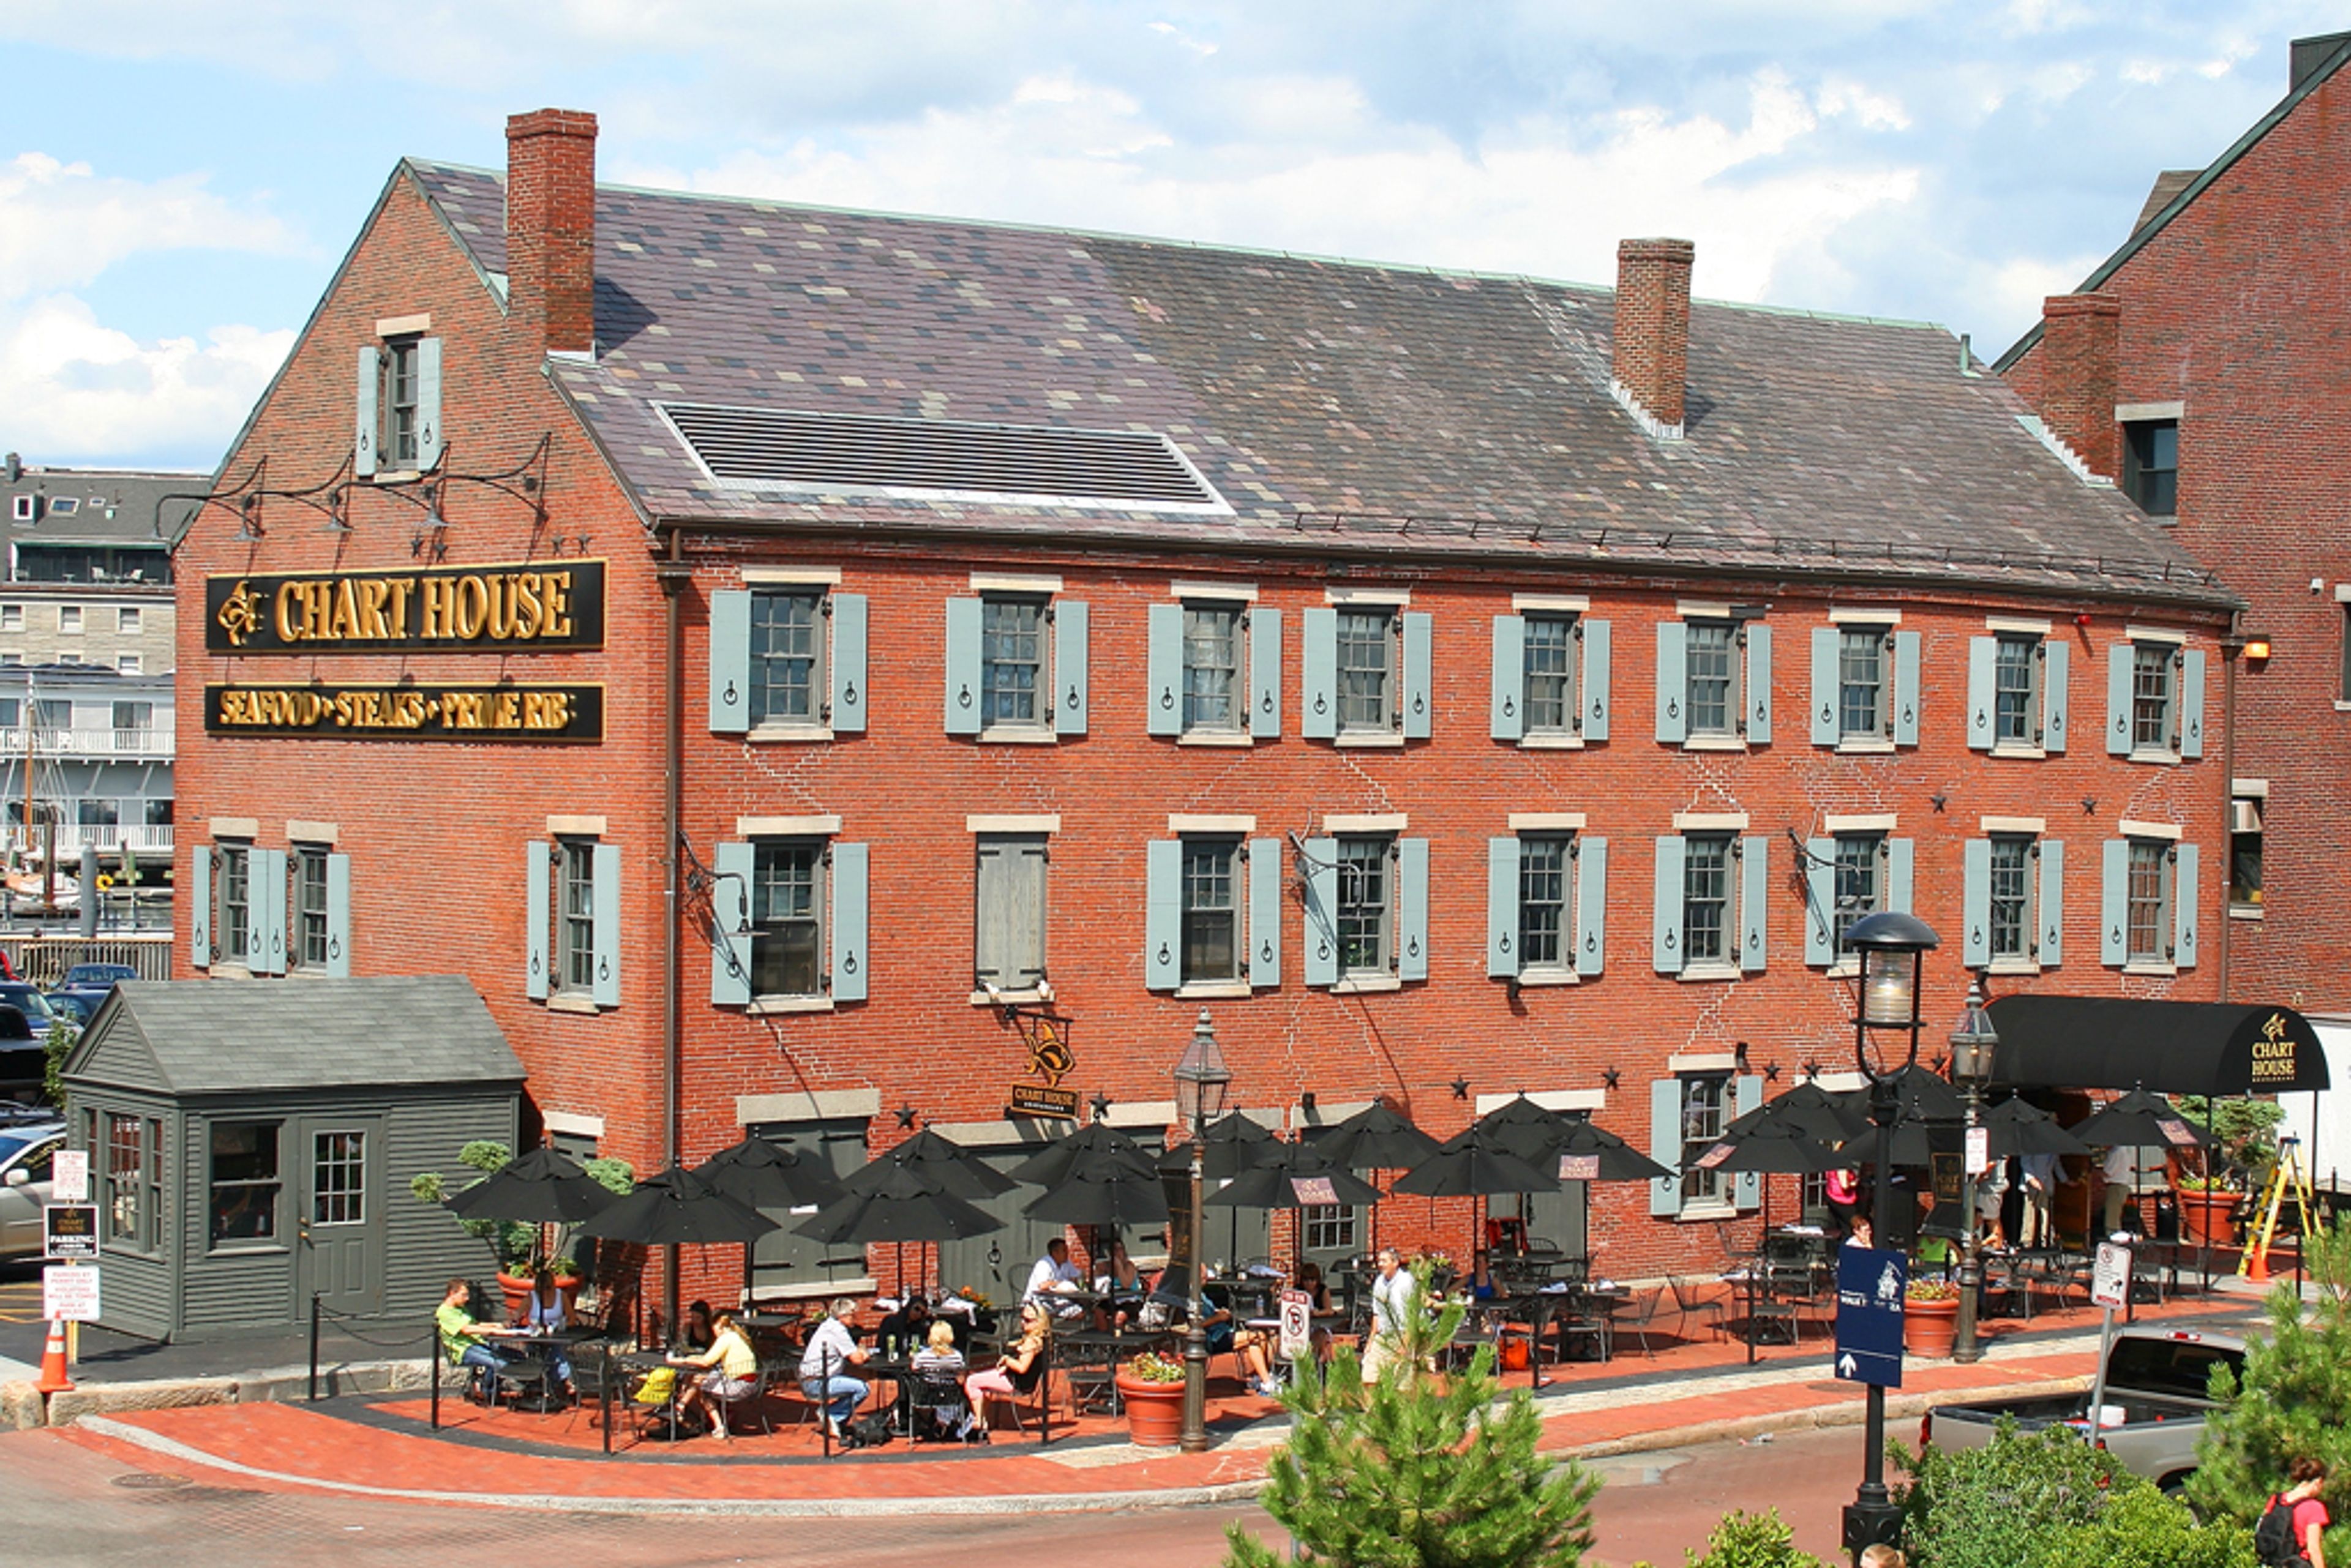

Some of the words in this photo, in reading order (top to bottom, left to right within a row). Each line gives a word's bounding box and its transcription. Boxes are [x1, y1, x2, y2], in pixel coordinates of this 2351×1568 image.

[275, 578, 415, 642] CHART
[420, 571, 572, 640] HOUSE
[220, 690, 320, 726] SEAFOOD
[441, 692, 520, 729] PRIME
[523, 692, 569, 729] RIB
[2252, 1042, 2295, 1059] CHART
[2252, 1059, 2295, 1076] HOUSE
[1014, 1087, 1043, 1102] CHART
[50, 1235, 95, 1244] PARKING
